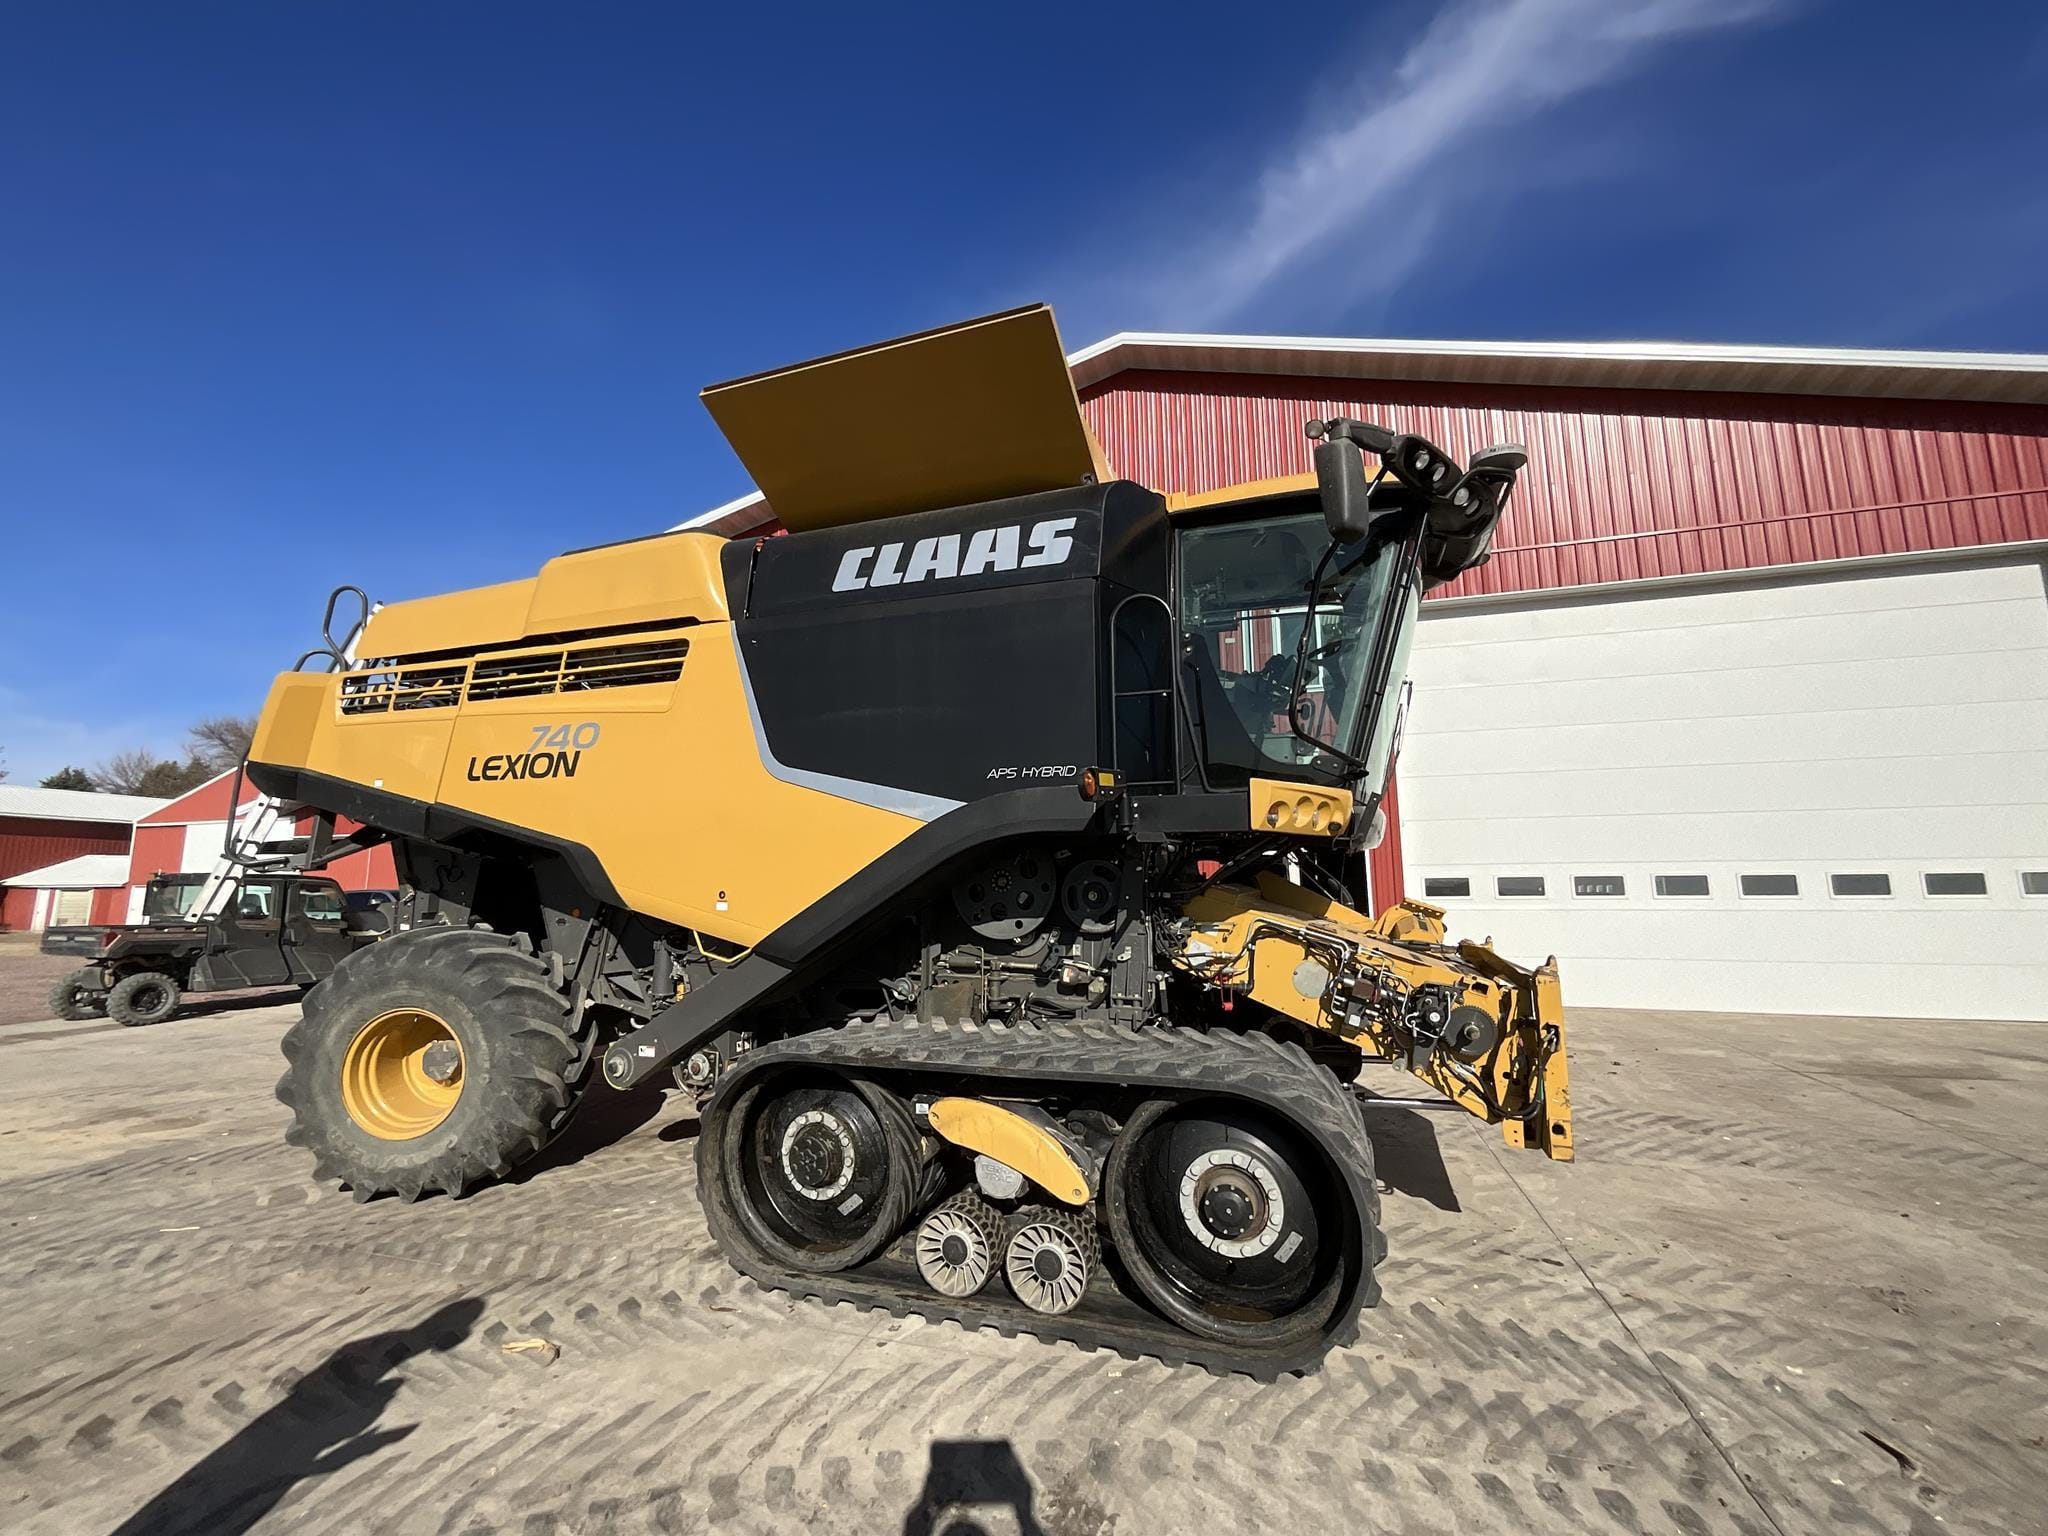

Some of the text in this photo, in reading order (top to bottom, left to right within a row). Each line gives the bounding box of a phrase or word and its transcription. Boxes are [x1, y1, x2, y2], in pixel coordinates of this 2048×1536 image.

[831, 517, 1077, 592] CLAAS
[527, 722, 600, 753] 740
[467, 750, 580, 781] LEXION
[986, 765, 1077, 779] APS HYBRID
